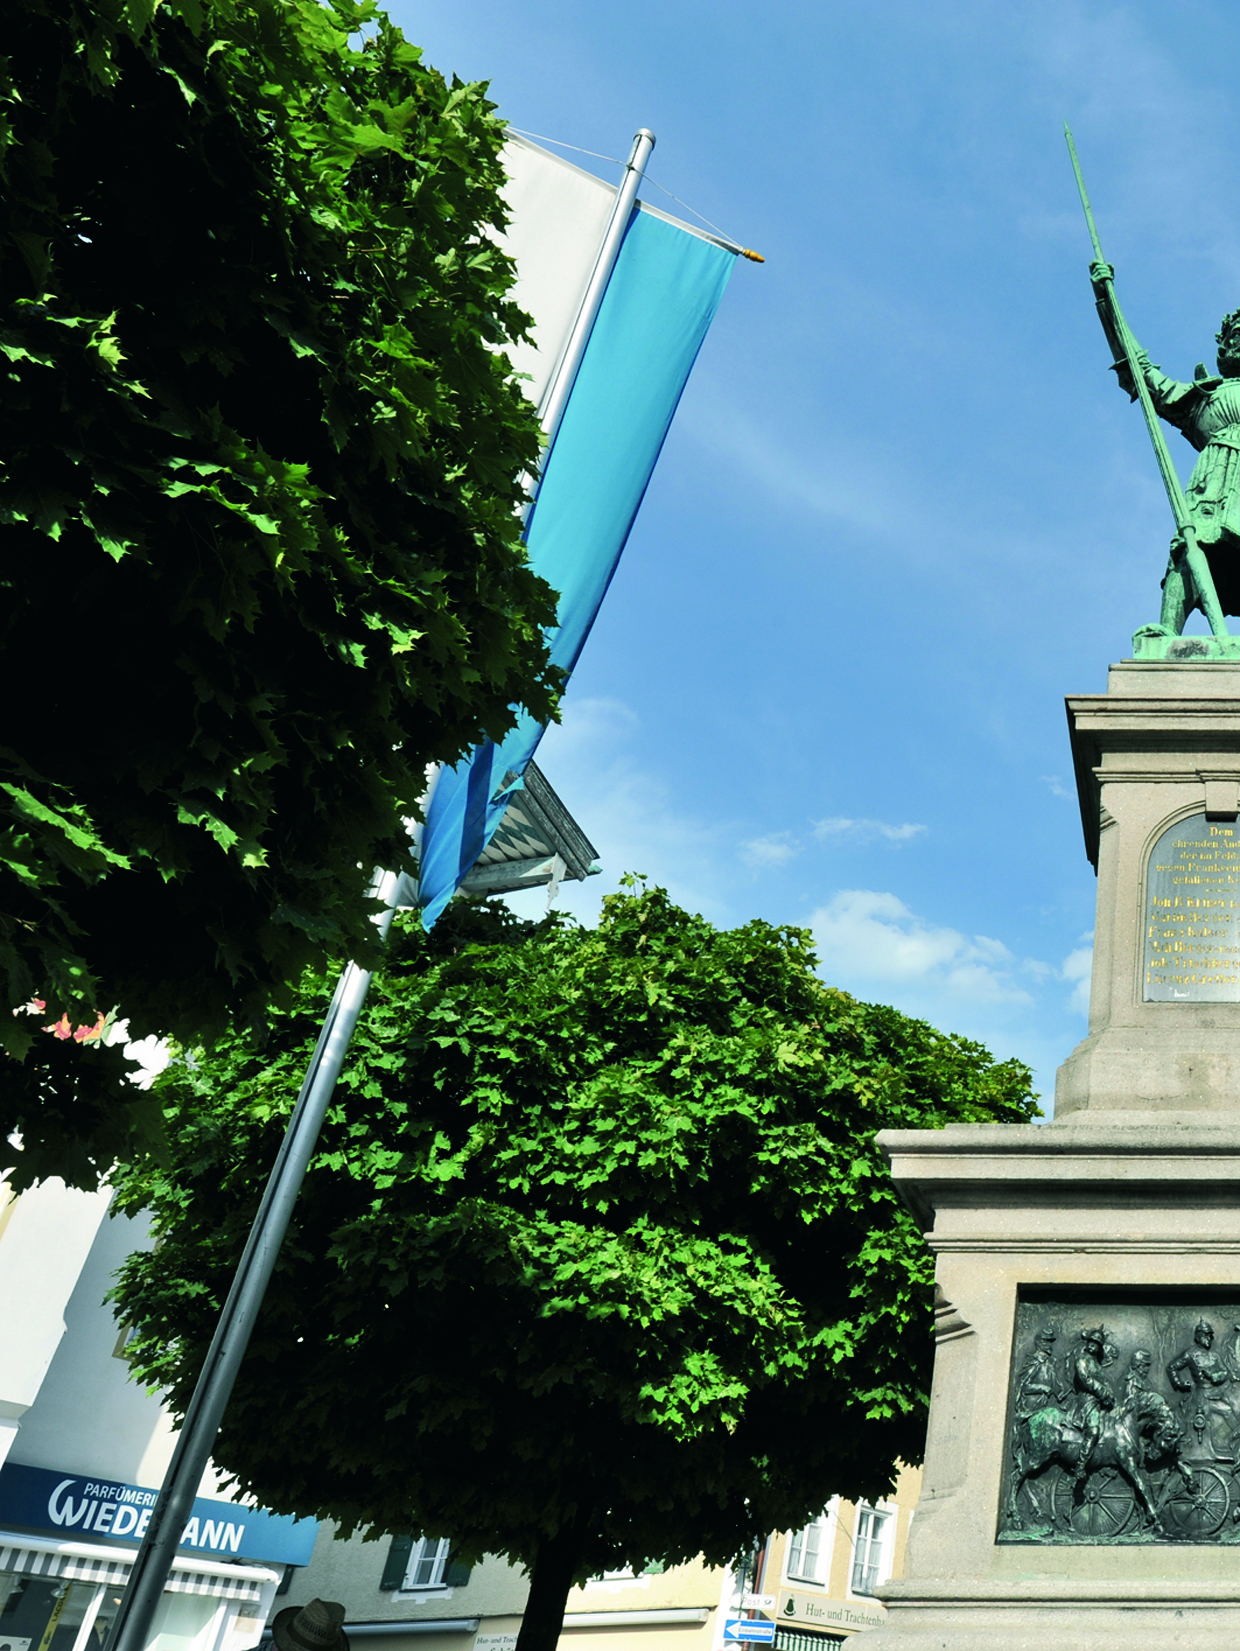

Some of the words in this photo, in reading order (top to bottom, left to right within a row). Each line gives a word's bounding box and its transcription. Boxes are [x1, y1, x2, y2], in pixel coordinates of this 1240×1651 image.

[1209, 826, 1233, 836] Dem
[83, 1482, 158, 1507] PARFÜMERI
[48, 1479, 245, 1553] WIEDEANN
[742, 1596, 760, 1606] Post
[805, 1603, 825, 1618] Hut-
[827, 1609, 842, 1621] und
[844, 1609, 886, 1627] Trachtenha
